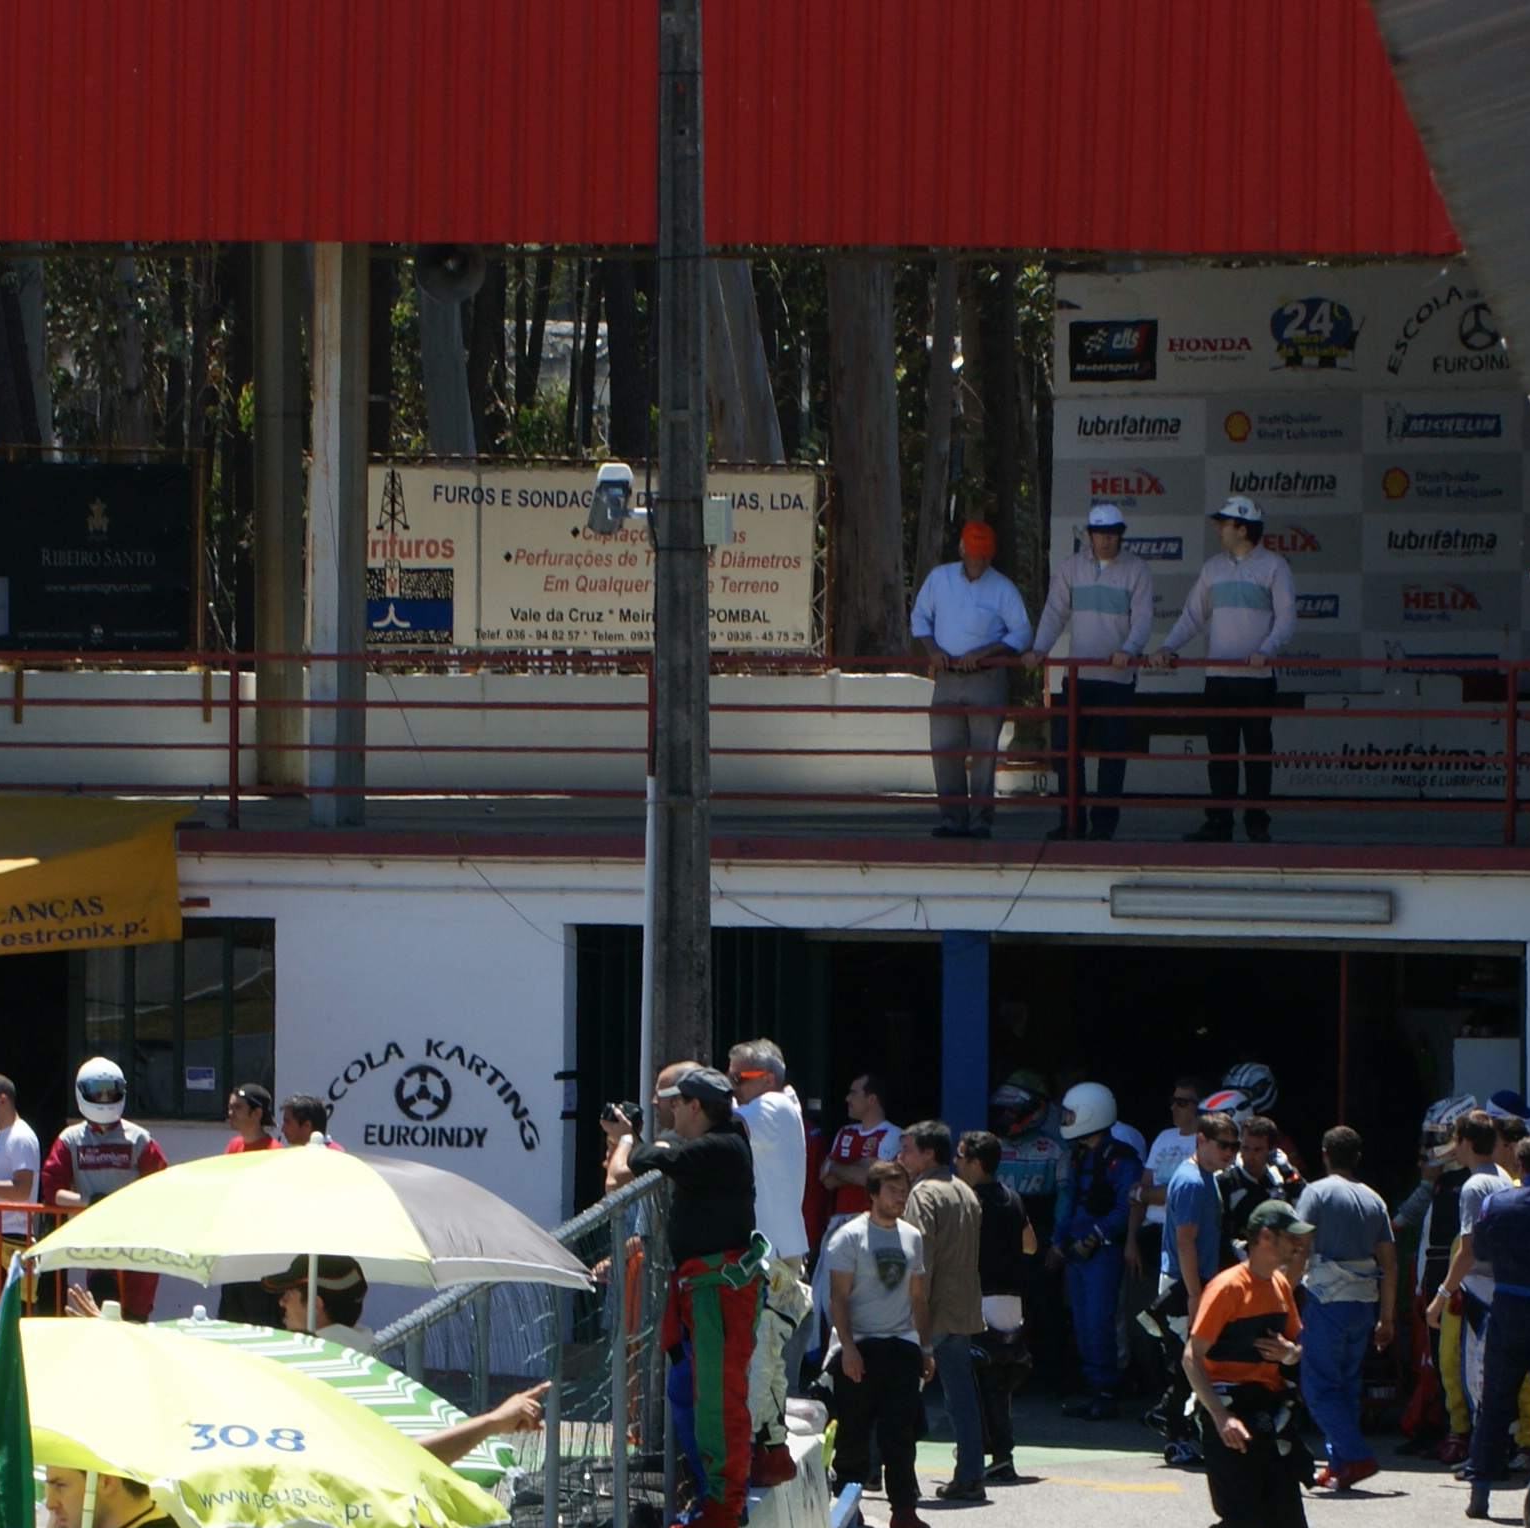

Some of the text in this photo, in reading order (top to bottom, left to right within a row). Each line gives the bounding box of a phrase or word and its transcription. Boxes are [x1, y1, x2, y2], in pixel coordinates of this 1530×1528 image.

[1282, 300, 1335, 339] 24
[1387, 285, 1463, 376] ESCOLA
[1168, 337, 1253, 352] HONDA
[1409, 416, 1497, 433] MICHELIN
[1090, 476, 1165, 495] HELIX
[433, 484, 496, 506] FUROS
[501, 489, 512, 507] E
[517, 489, 594, 508] SONDAG
[770, 492, 809, 511] LDA.
[368, 531, 455, 560] rifuros
[1262, 534, 1319, 551] ELIX
[41, 548, 156, 567] RIBEIRO SANTO
[513, 548, 613, 569] Perfurações
[618, 551, 638, 567] de
[720, 550, 802, 570] Diâmetros
[543, 574, 570, 593] Em
[575, 574, 652, 594] Qualquer
[719, 576, 780, 594] Terreno
[1402, 591, 1479, 611] HELIX
[510, 607, 542, 623] Vale
[545, 607, 564, 622] da
[568, 607, 604, 623] Cruz
[707, 608, 771, 624] POMBAL
[506, 629, 526, 641] 036
[535, 629, 549, 641] 94
[551, 629, 564, 641] 82
[567, 629, 581, 641] 57
[726, 631, 753, 643] 0936
[1032, 774, 1048, 790] 10
[1438, 775, 1521, 788] LUBRIFICANTS
[326, 1037, 540, 1152] SCOLA KARTING
[363, 1123, 488, 1149] EUROINDY
[187, 1421, 307, 1452] 308
